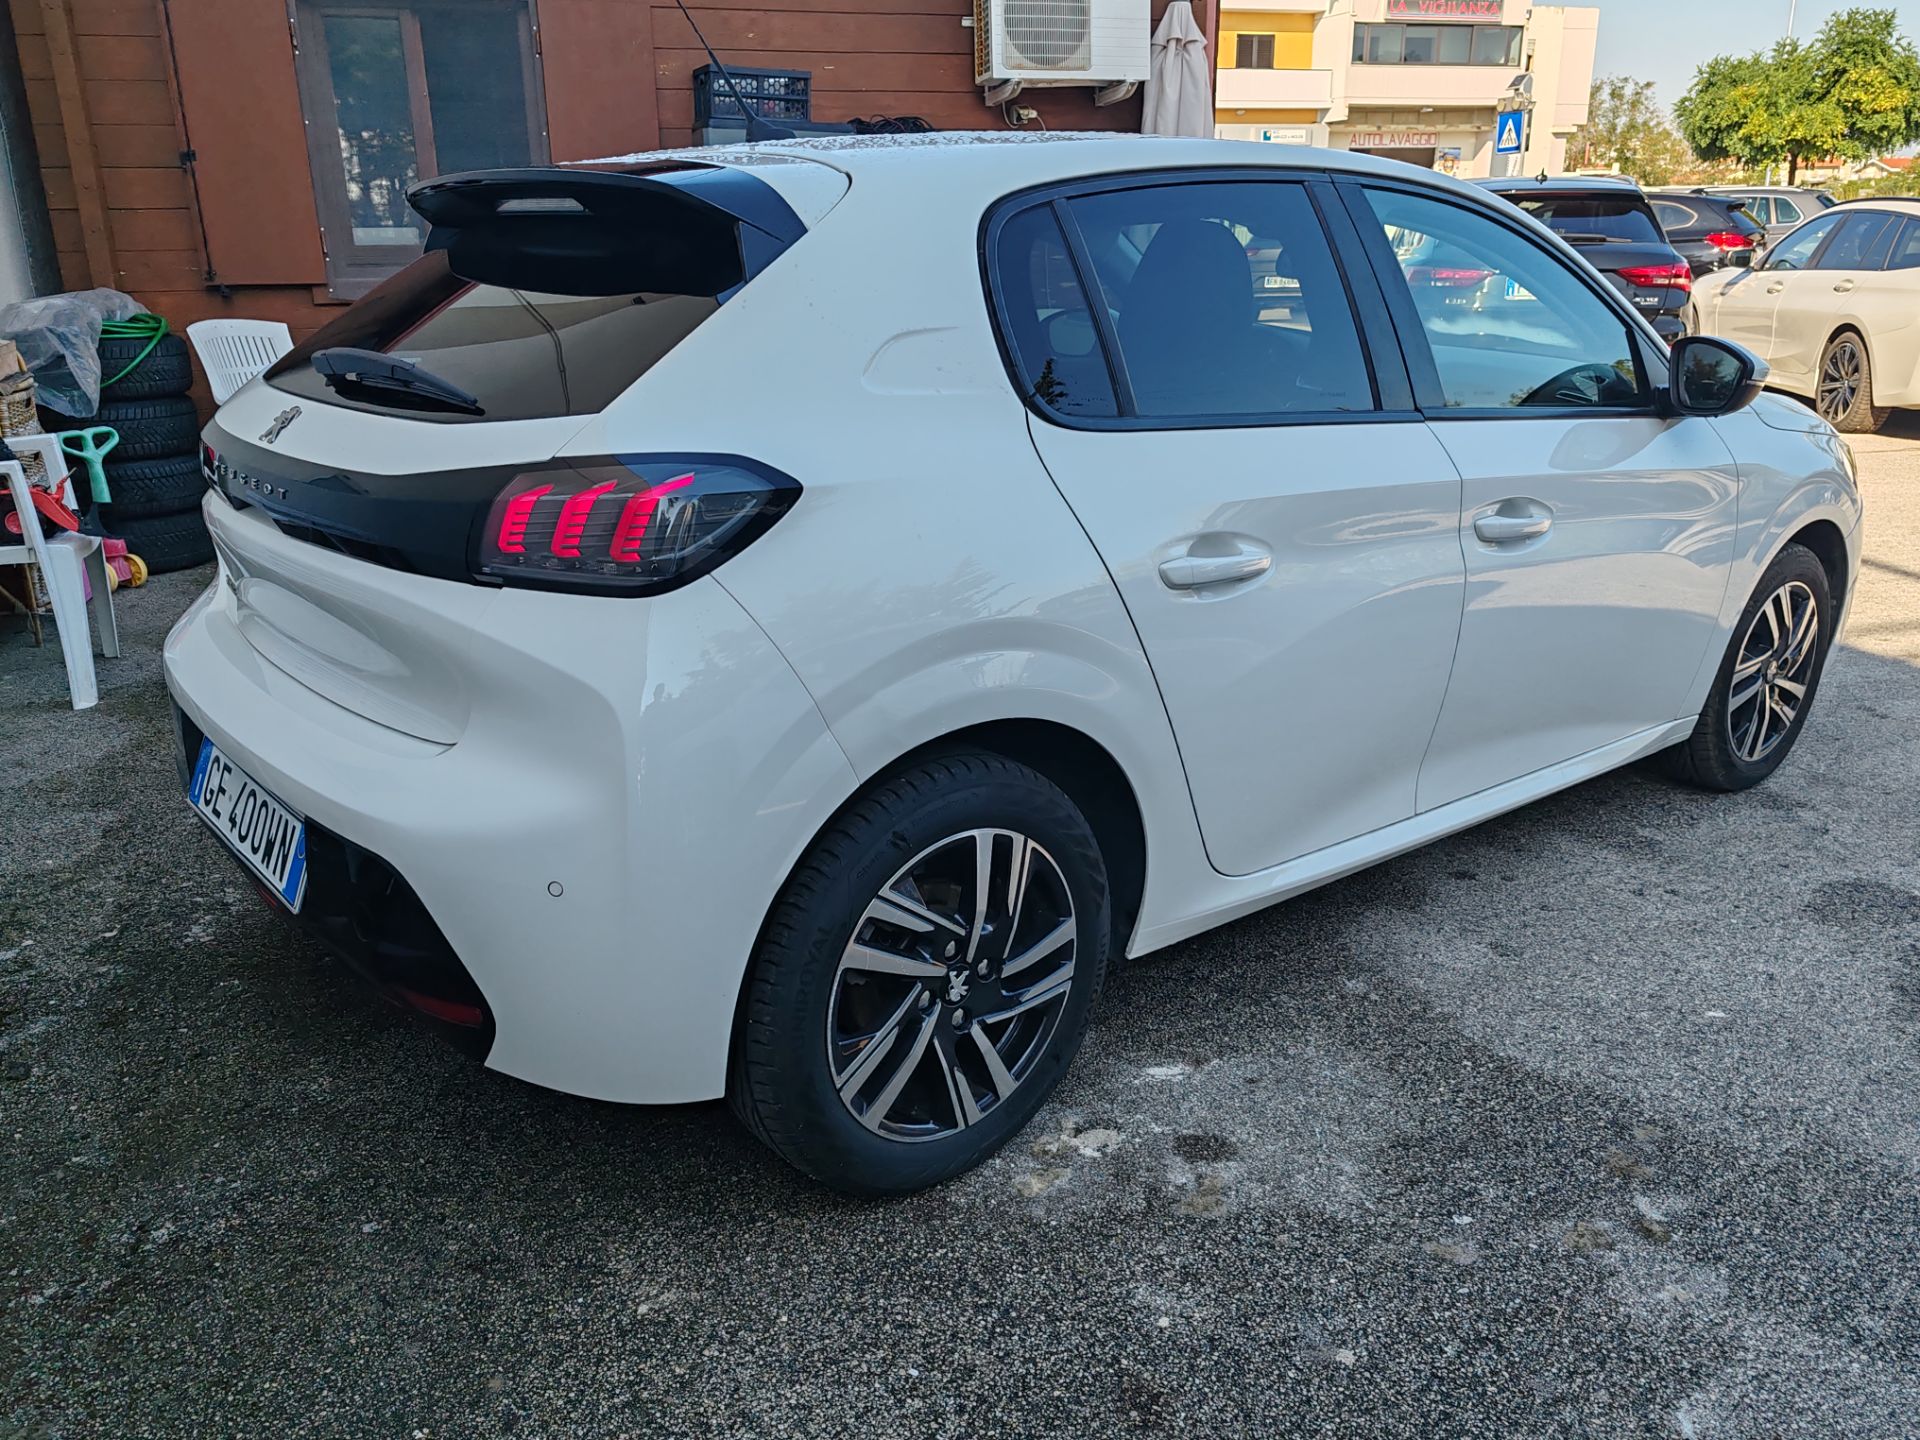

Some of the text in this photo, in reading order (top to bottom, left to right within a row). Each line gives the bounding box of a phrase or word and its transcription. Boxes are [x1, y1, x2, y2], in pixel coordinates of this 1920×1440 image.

[1388, 0, 1501, 15] LA VIGILANZA
[1349, 131, 1438, 147] AUTOLAVAGGIO
[213, 460, 289, 500] PEUGEOT
